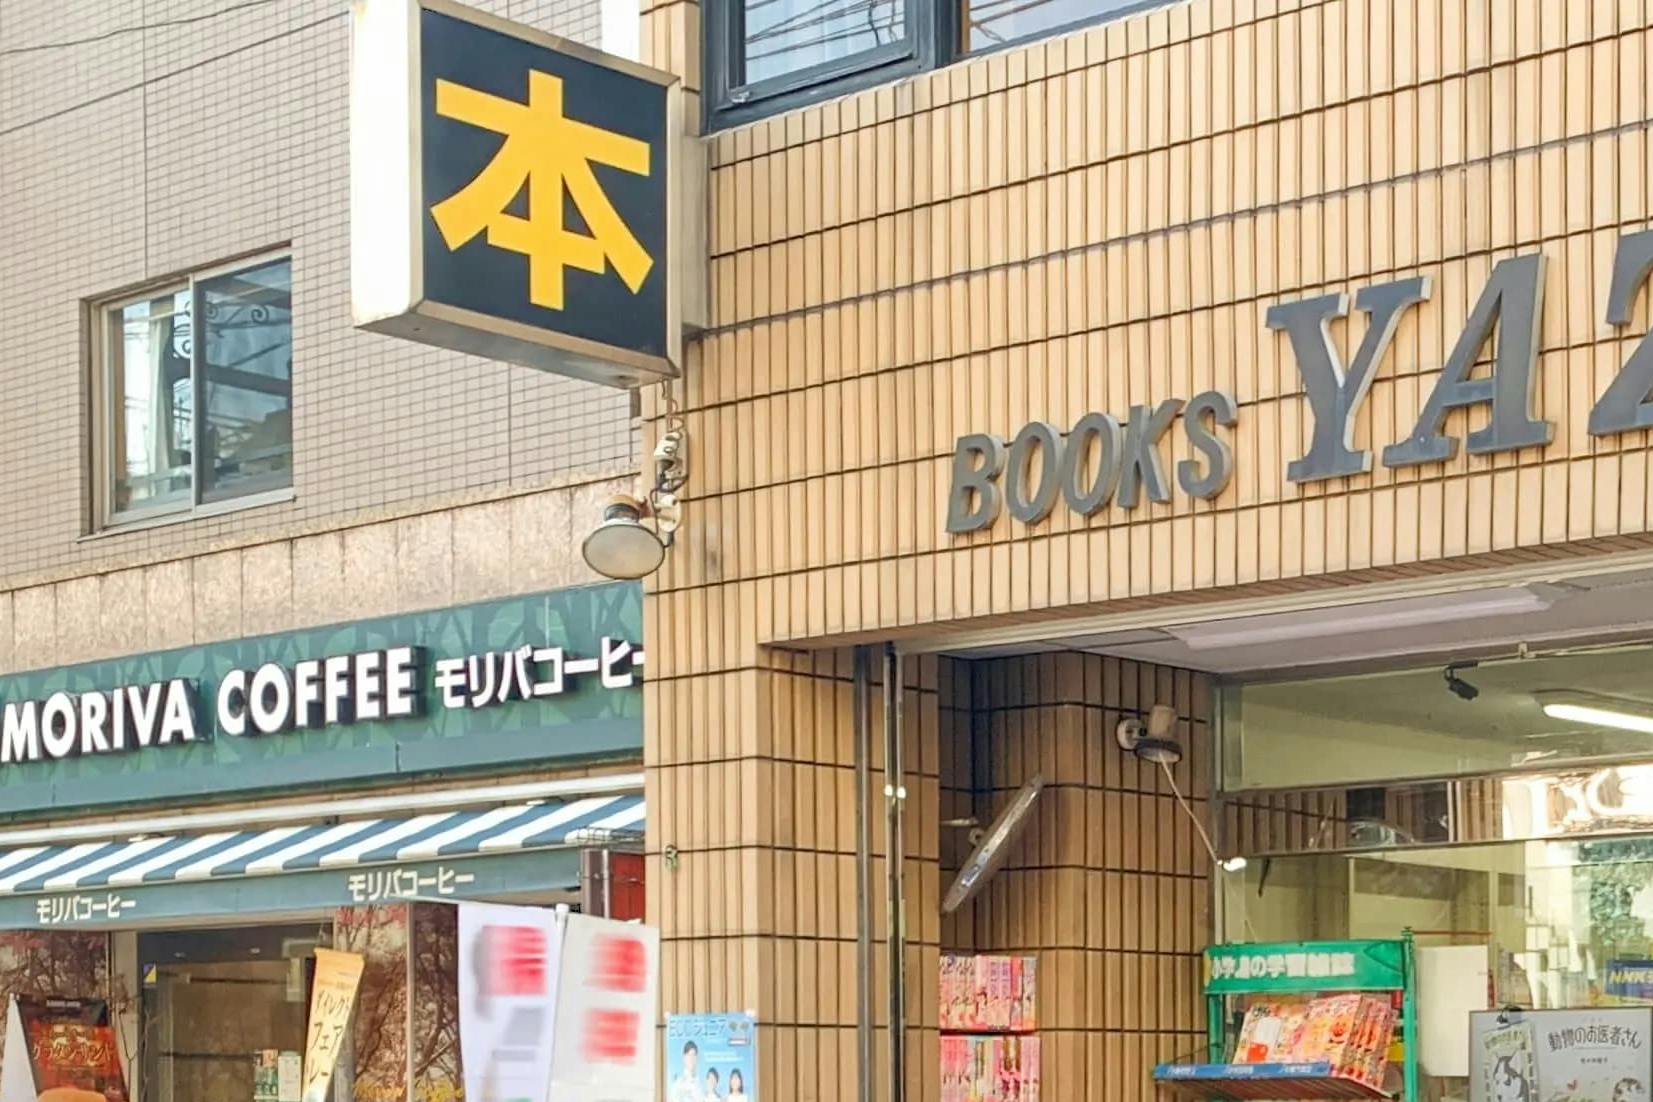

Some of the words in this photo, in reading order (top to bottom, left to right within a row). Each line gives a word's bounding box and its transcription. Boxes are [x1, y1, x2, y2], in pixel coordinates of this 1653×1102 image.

[429, 68, 654, 311] 本
[945, 391, 1239, 535] BOOKS
[0, 678, 196, 763] MORIVA
[217, 646, 413, 736] COFFEE
[36, 893, 136, 926] モリバコーヒー
[348, 866, 475, 902] モリバコーヒー
[1548, 1025, 1642, 1051] 動物のお医者さん
